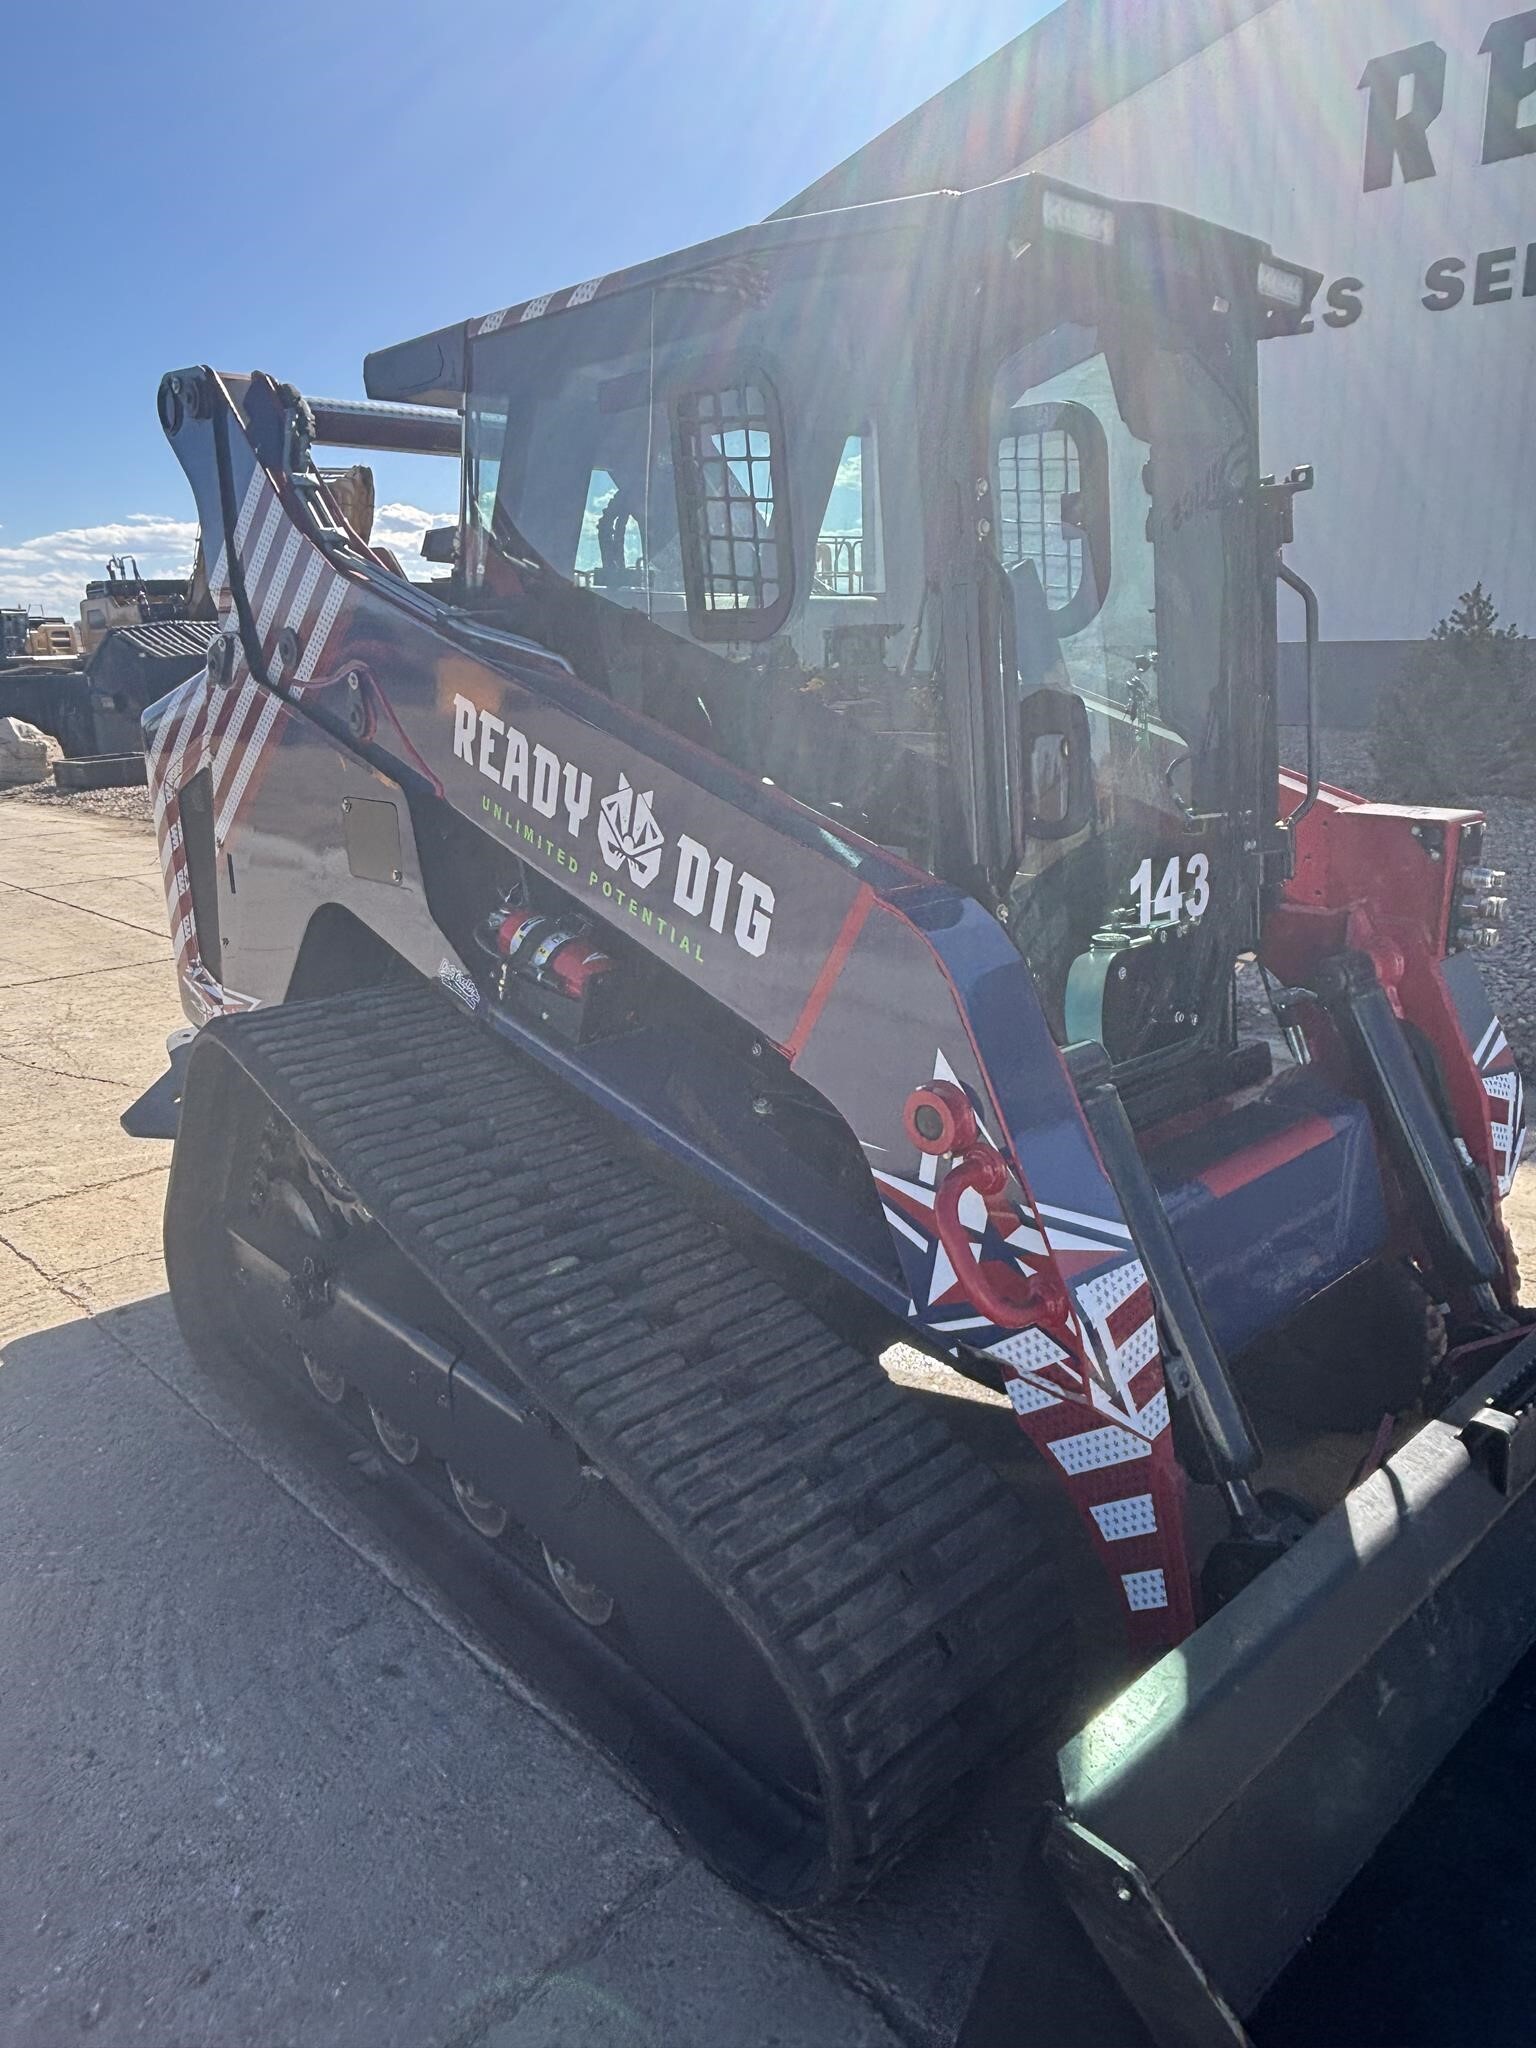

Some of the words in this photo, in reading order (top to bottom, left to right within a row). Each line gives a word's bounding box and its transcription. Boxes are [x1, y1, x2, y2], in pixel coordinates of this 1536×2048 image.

[1300, 276, 1364, 333] S
[453, 693, 592, 837] READY
[673, 834, 775, 957] DIG
[482, 795, 578, 873] UNLIMITED
[589, 871, 704, 964] POTENTIAL
[1130, 853, 1210, 926] 143
